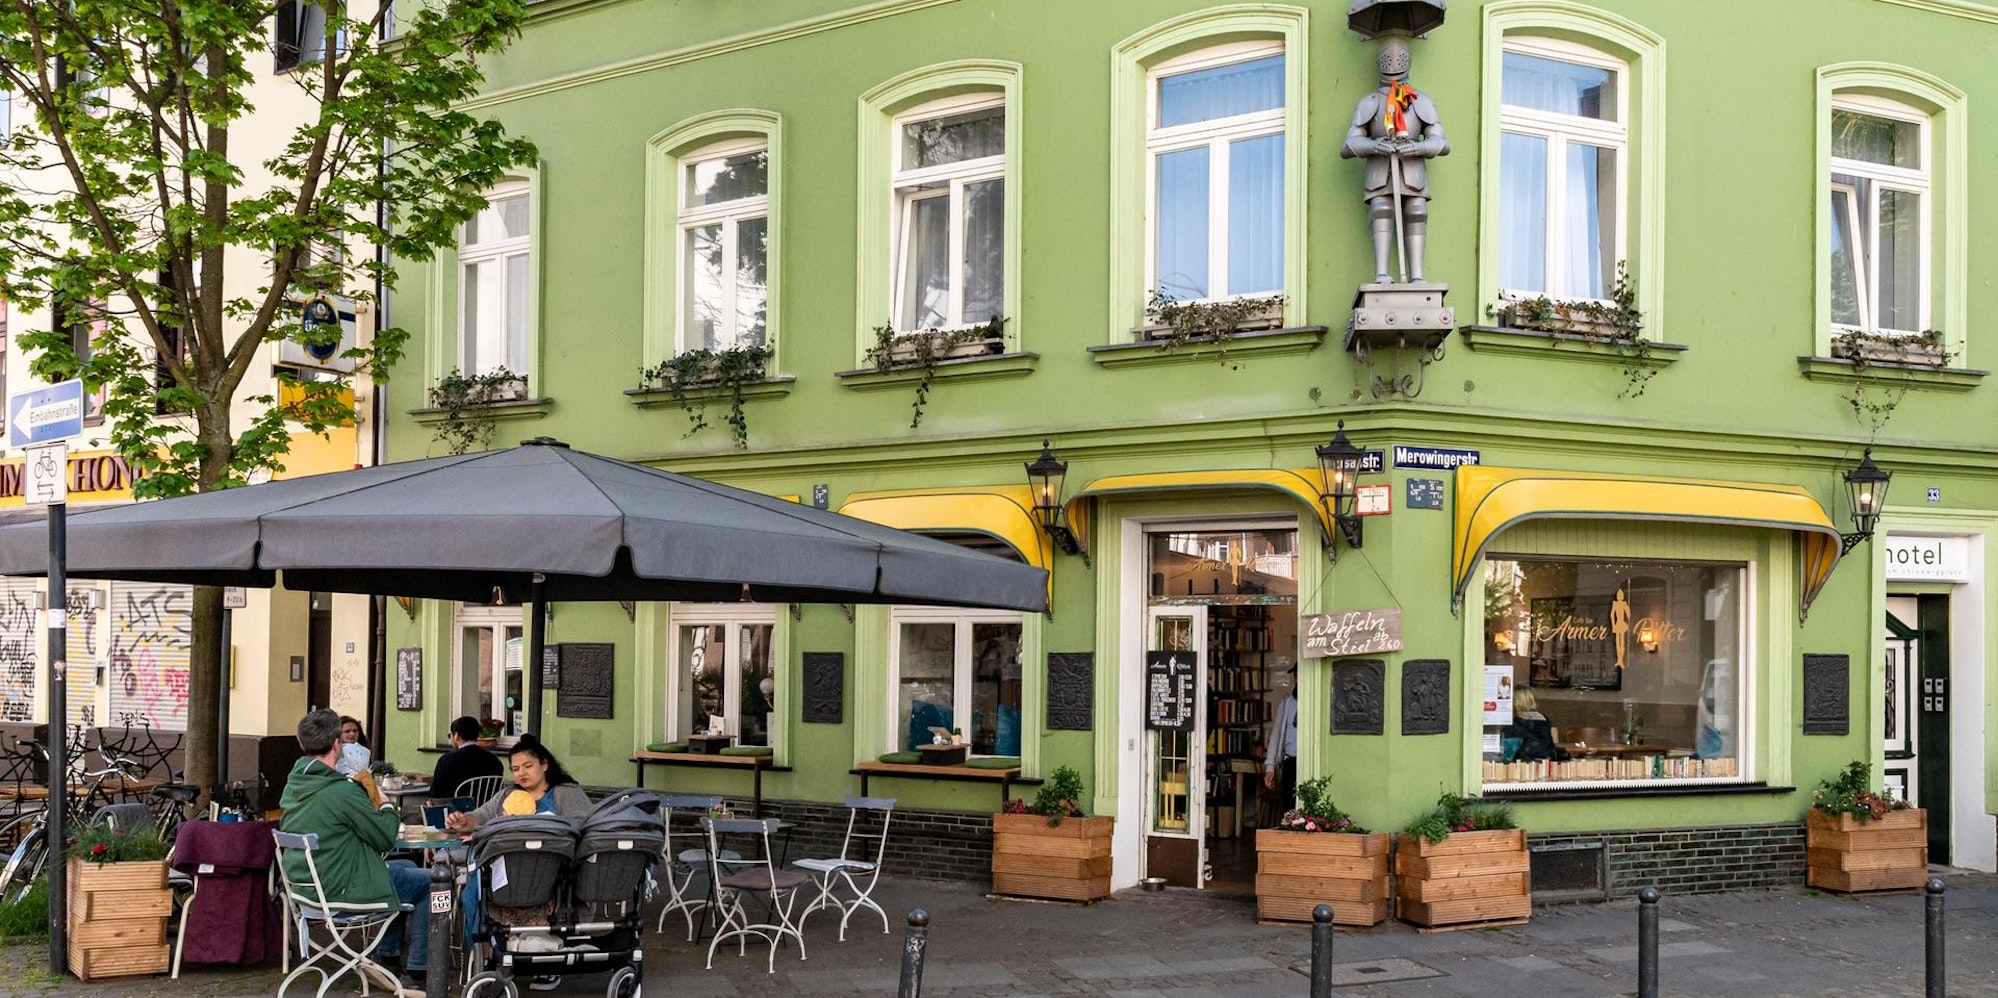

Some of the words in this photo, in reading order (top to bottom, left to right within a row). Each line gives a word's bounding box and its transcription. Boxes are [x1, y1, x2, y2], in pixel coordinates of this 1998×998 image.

[30, 403, 79, 423] Einbahnstraße
[1927, 488, 1939, 500] 33
[1308, 612, 1386, 639] Waffeln
[1536, 615, 1608, 642] Armer
[1306, 637, 1327, 648] am
[1324, 637, 1371, 655] Stiel
[1373, 631, 1389, 642] ab
